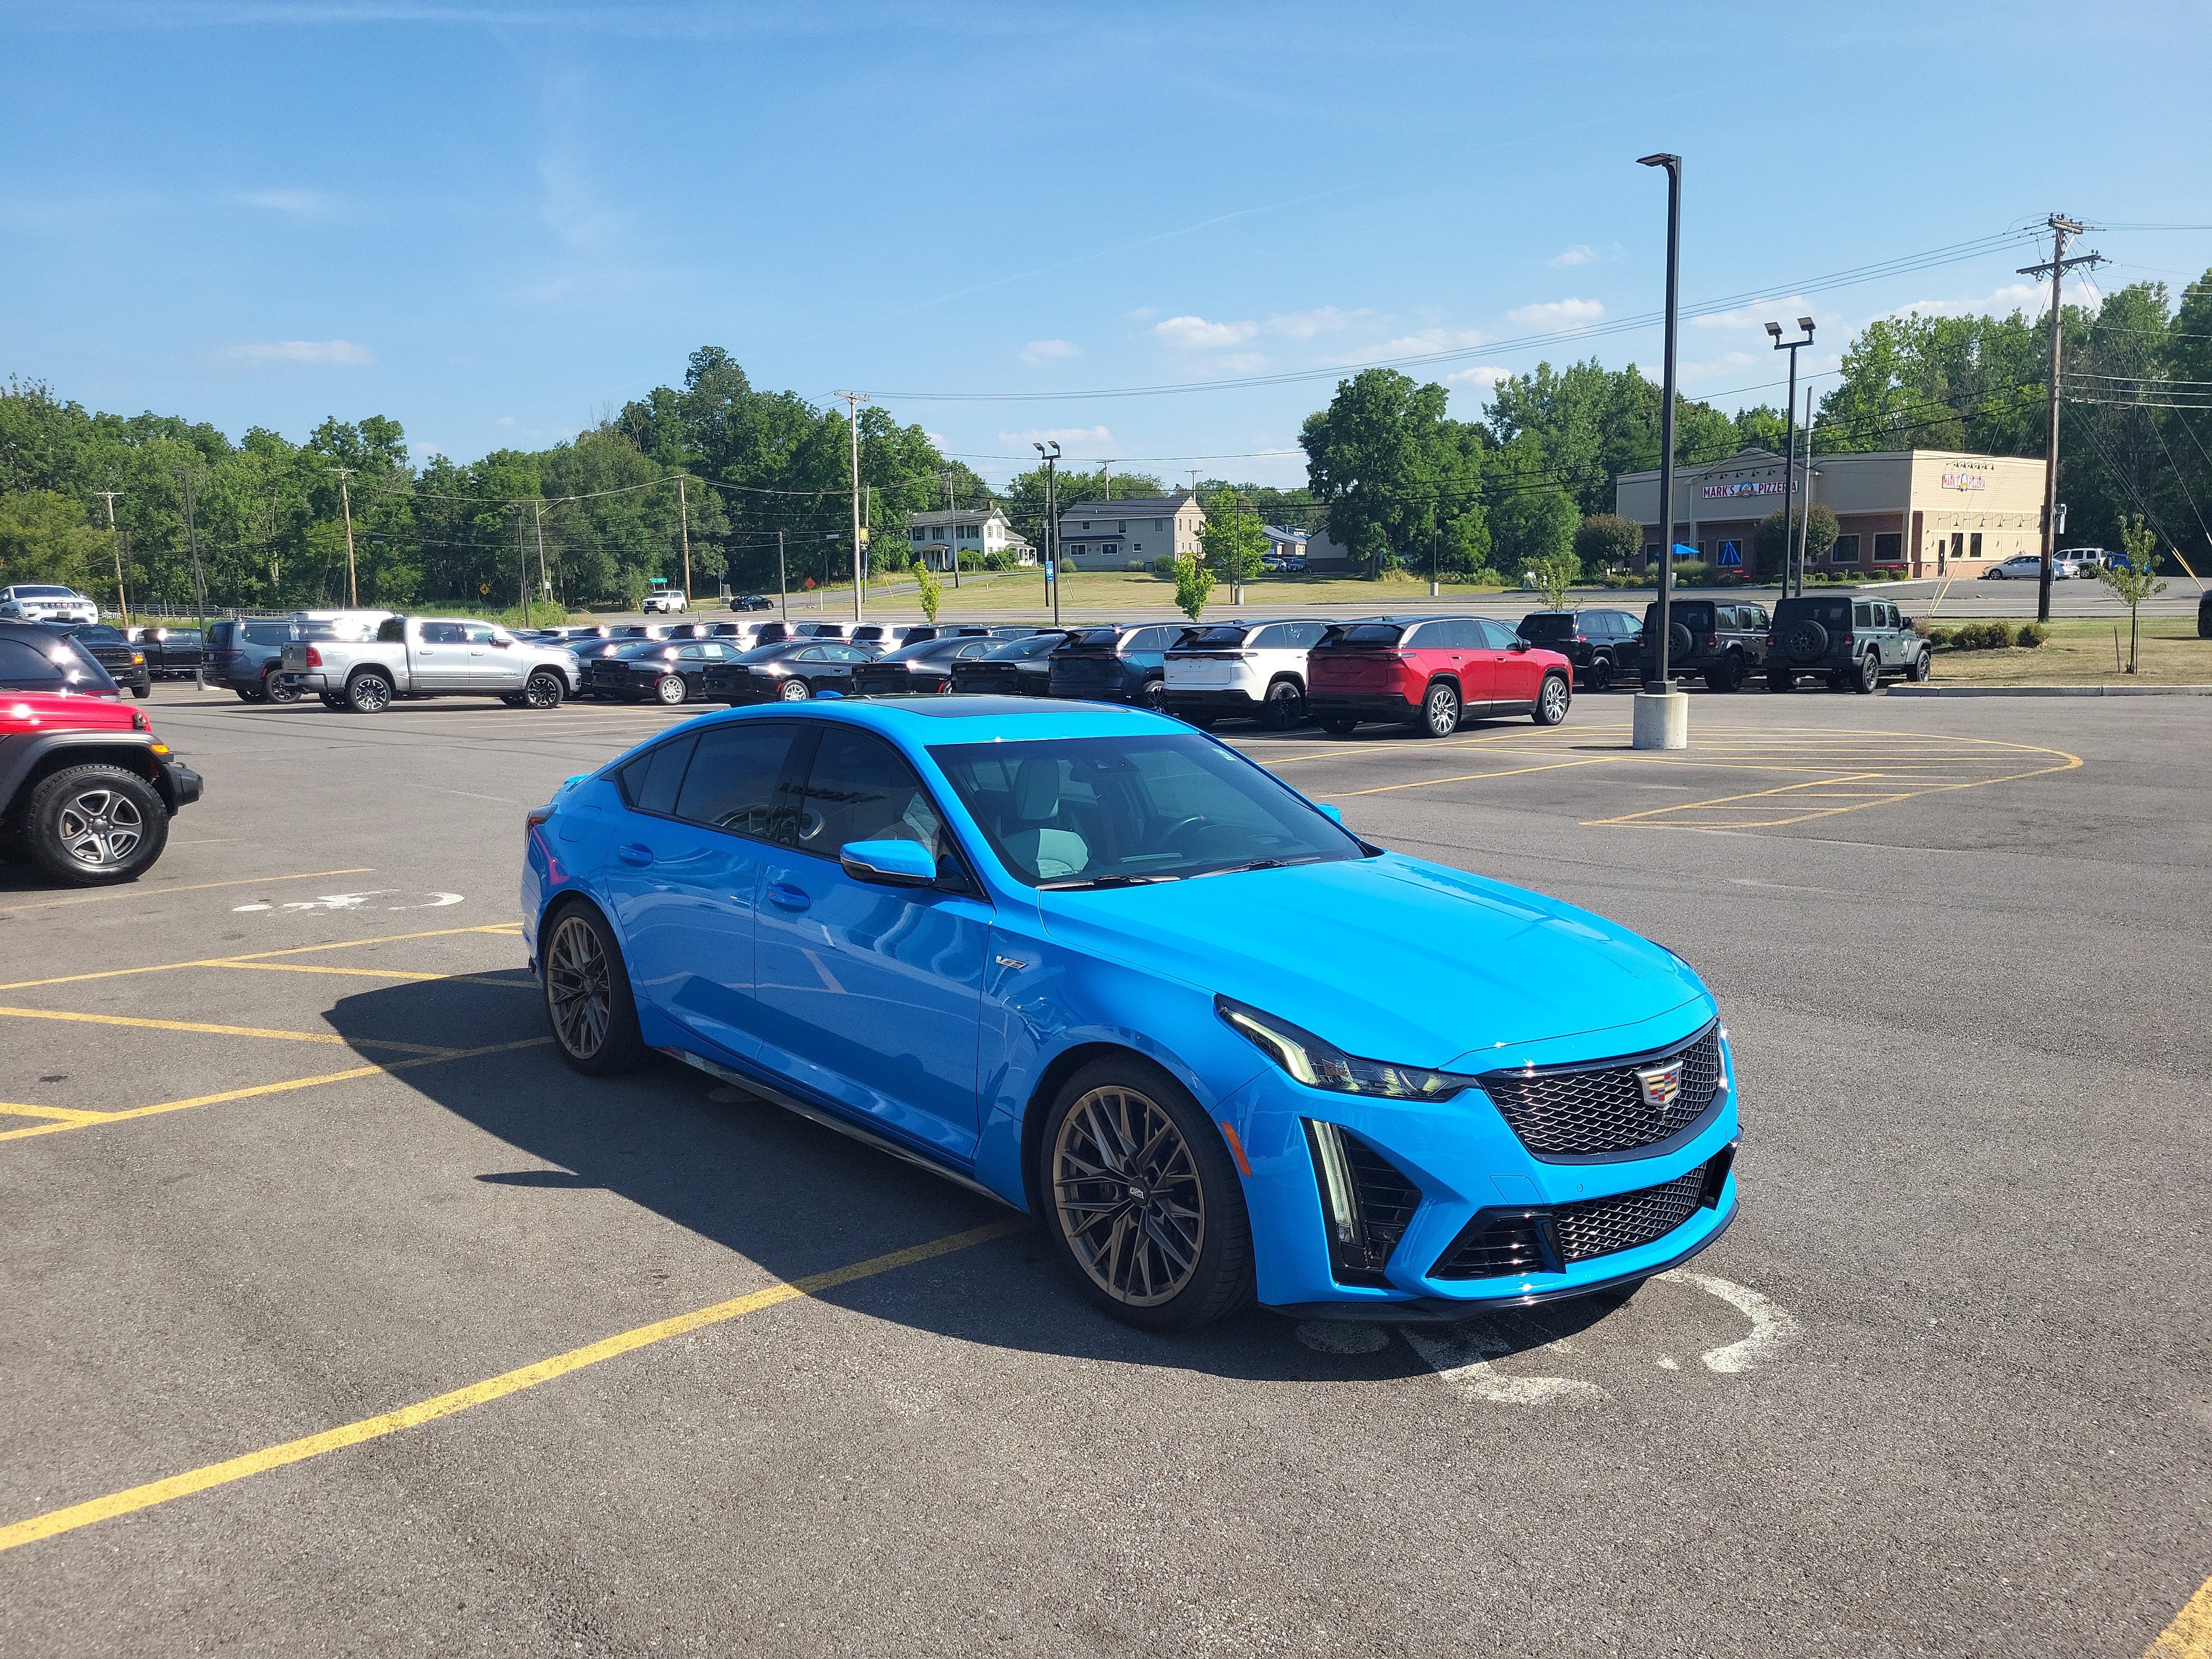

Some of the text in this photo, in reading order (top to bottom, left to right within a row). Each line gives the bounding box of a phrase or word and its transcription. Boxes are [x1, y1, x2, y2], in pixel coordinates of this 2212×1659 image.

[1943, 474, 1959, 487] MARK'S
[1703, 481, 1797, 497] MARK'S PIZZERA
